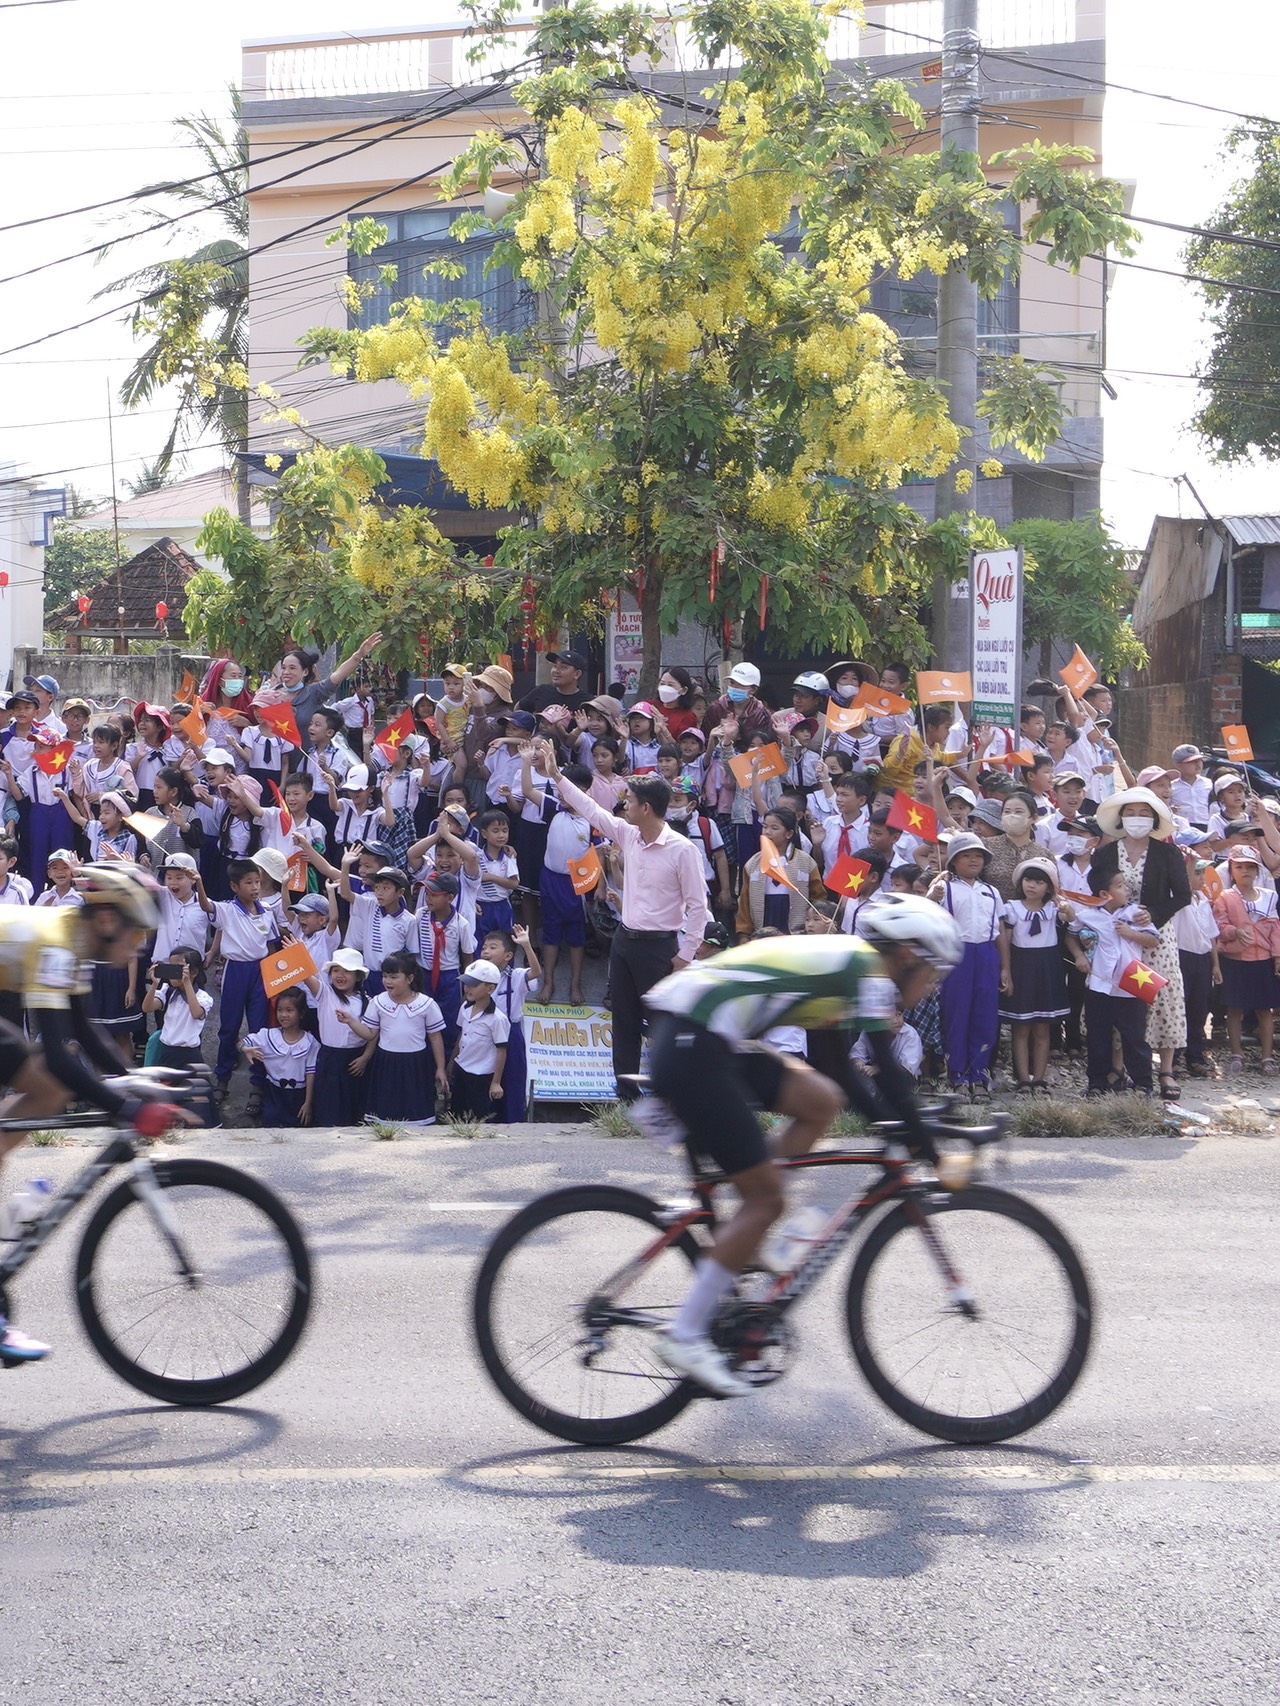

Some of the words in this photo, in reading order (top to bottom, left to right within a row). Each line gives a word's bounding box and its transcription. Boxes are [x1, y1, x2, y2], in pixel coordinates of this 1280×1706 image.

[976, 557, 1015, 615] Quà
[270, 977, 283, 987] TON
[282, 969, 300, 981] DONG
[531, 1020, 589, 1046] AnhBa
